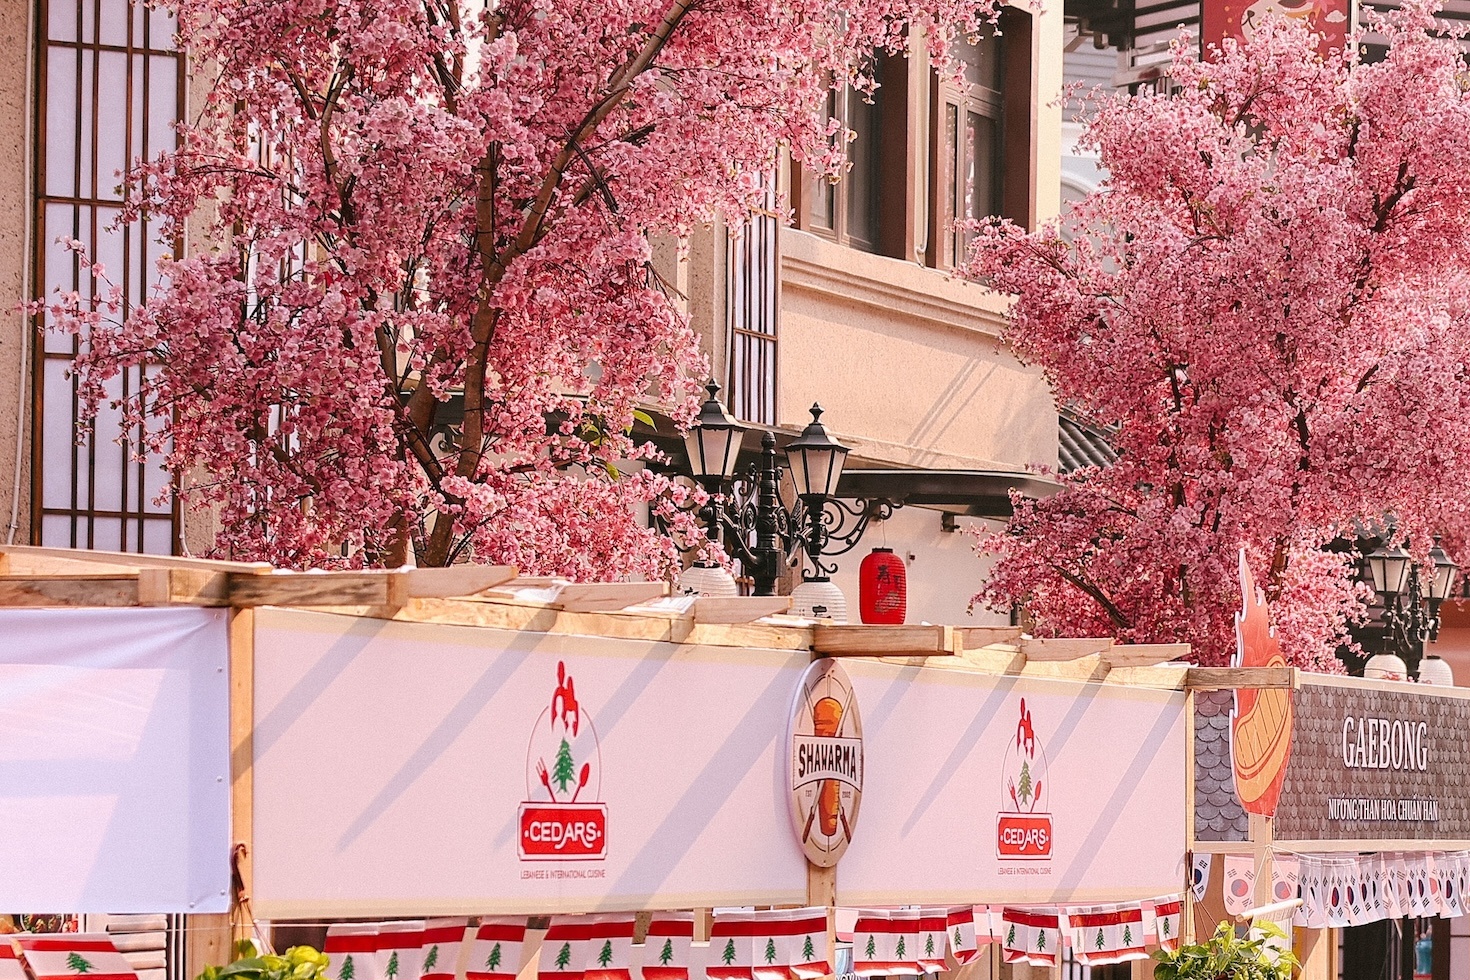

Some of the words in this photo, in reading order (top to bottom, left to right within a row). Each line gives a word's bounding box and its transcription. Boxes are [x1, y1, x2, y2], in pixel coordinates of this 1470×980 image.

[1343, 717, 1428, 770] GAEBONG
[799, 743, 857, 782] SHAWARMA
[1359, 798, 1380, 821] THAN
[1381, 799, 1397, 821] HOA
[1423, 795, 1439, 821] HÀN
[529, 821, 597, 849] CEDARS
[1003, 828, 1046, 850] CEDARS
